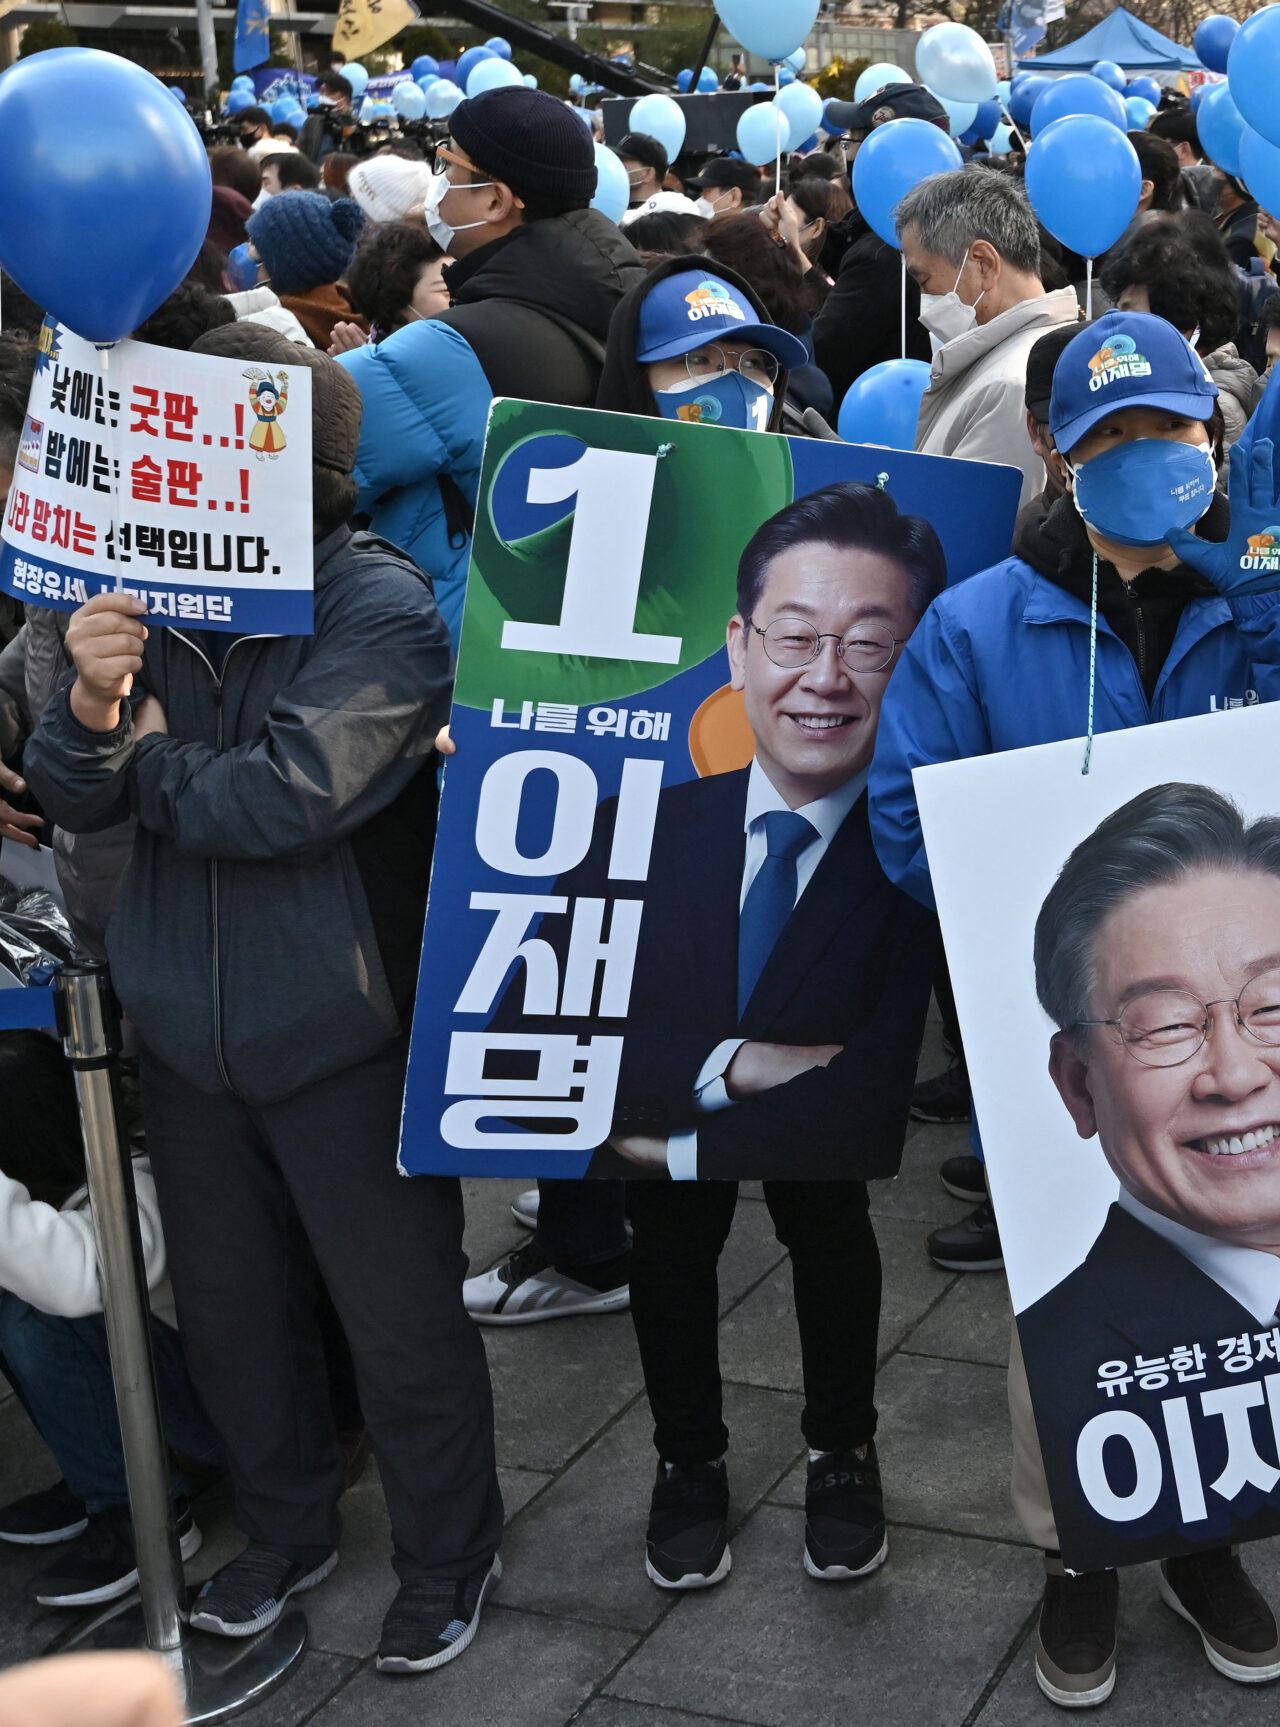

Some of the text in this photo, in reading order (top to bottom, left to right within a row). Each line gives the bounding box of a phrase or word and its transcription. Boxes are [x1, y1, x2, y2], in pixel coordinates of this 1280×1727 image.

[1088, 361, 1153, 392] 이재명
[31, 498, 97, 556] 망치는
[1250, 546, 1270, 555] 나를
[12, 558, 89, 603] 현장유세
[500, 447, 683, 665] 1
[490, 698, 672, 743] 나를 위해
[439, 749, 664, 1151] 이재명
[1095, 1343, 1207, 1398] 유능한
